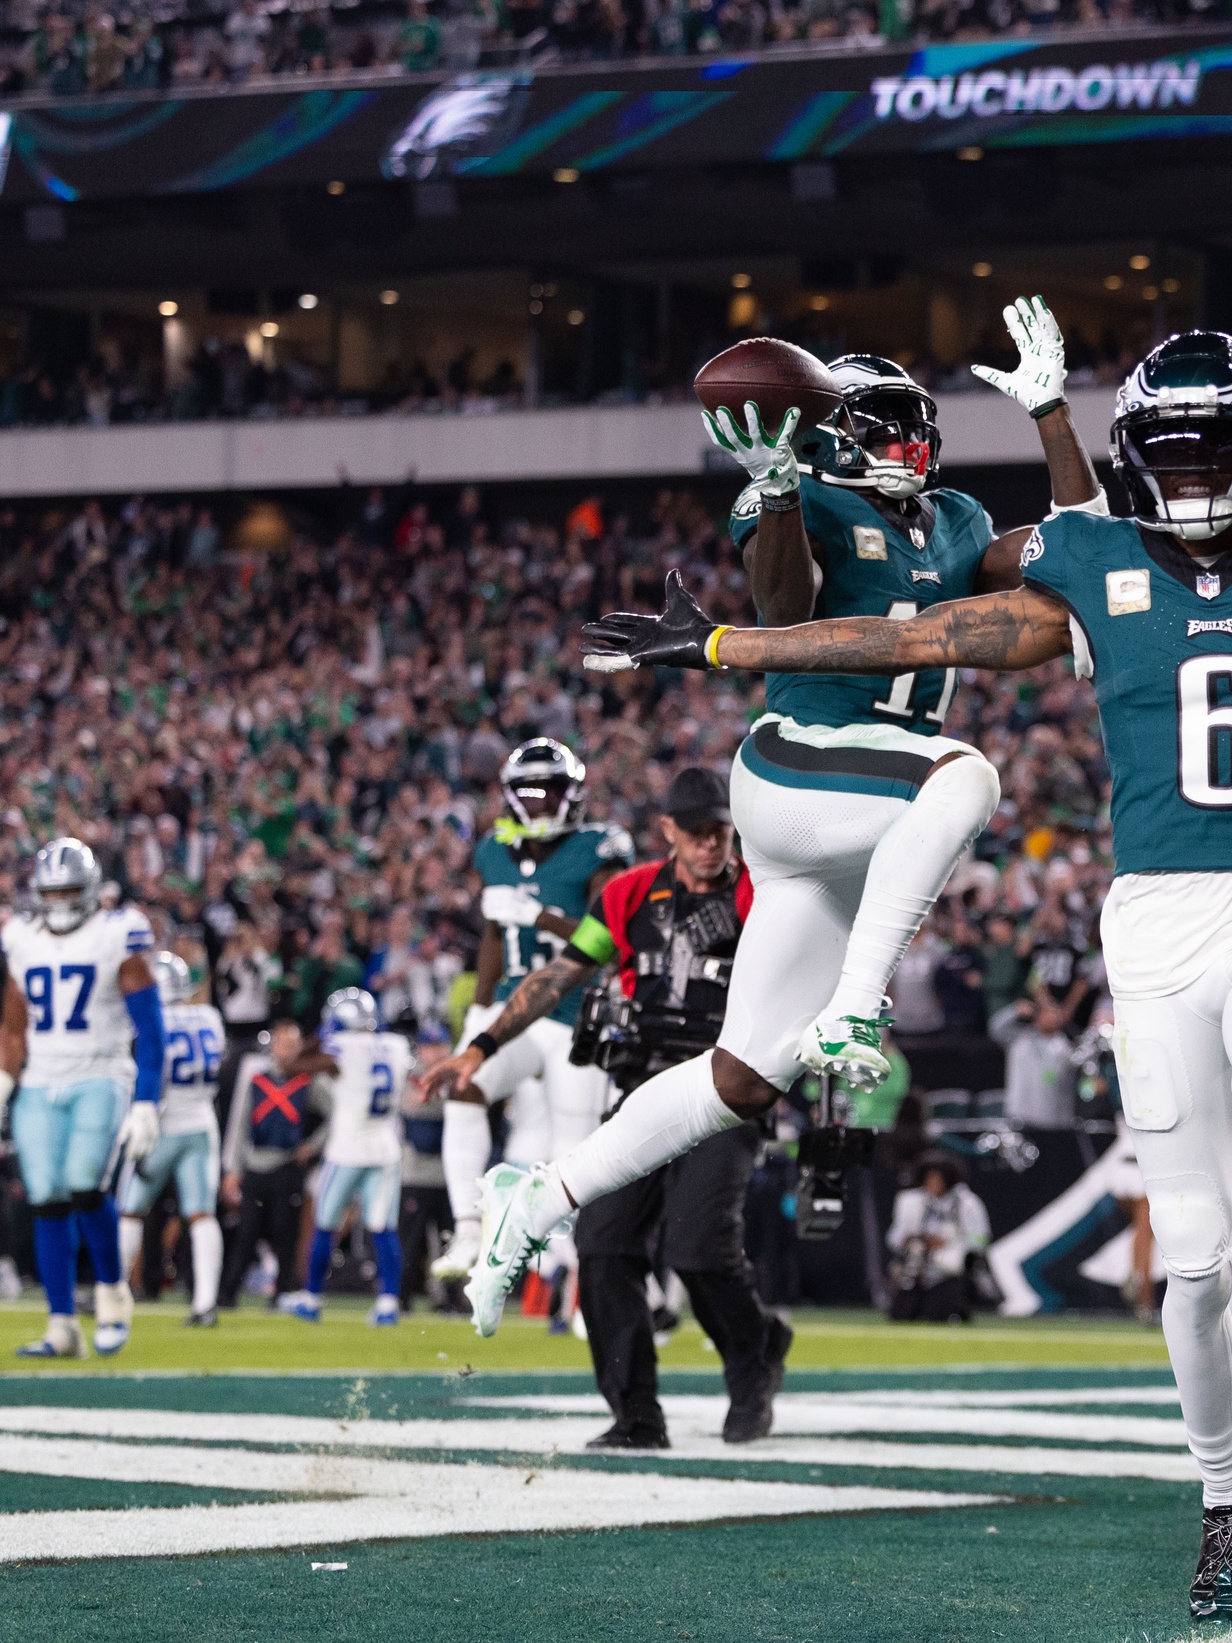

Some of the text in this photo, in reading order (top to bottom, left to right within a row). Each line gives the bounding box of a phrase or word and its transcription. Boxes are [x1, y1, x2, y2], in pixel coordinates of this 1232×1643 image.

[870, 59, 1201, 121] TOUCHDOWN
[25, 964, 97, 1032] 97
[167, 1028, 222, 1086] 26
[369, 1063, 395, 1115] 2
